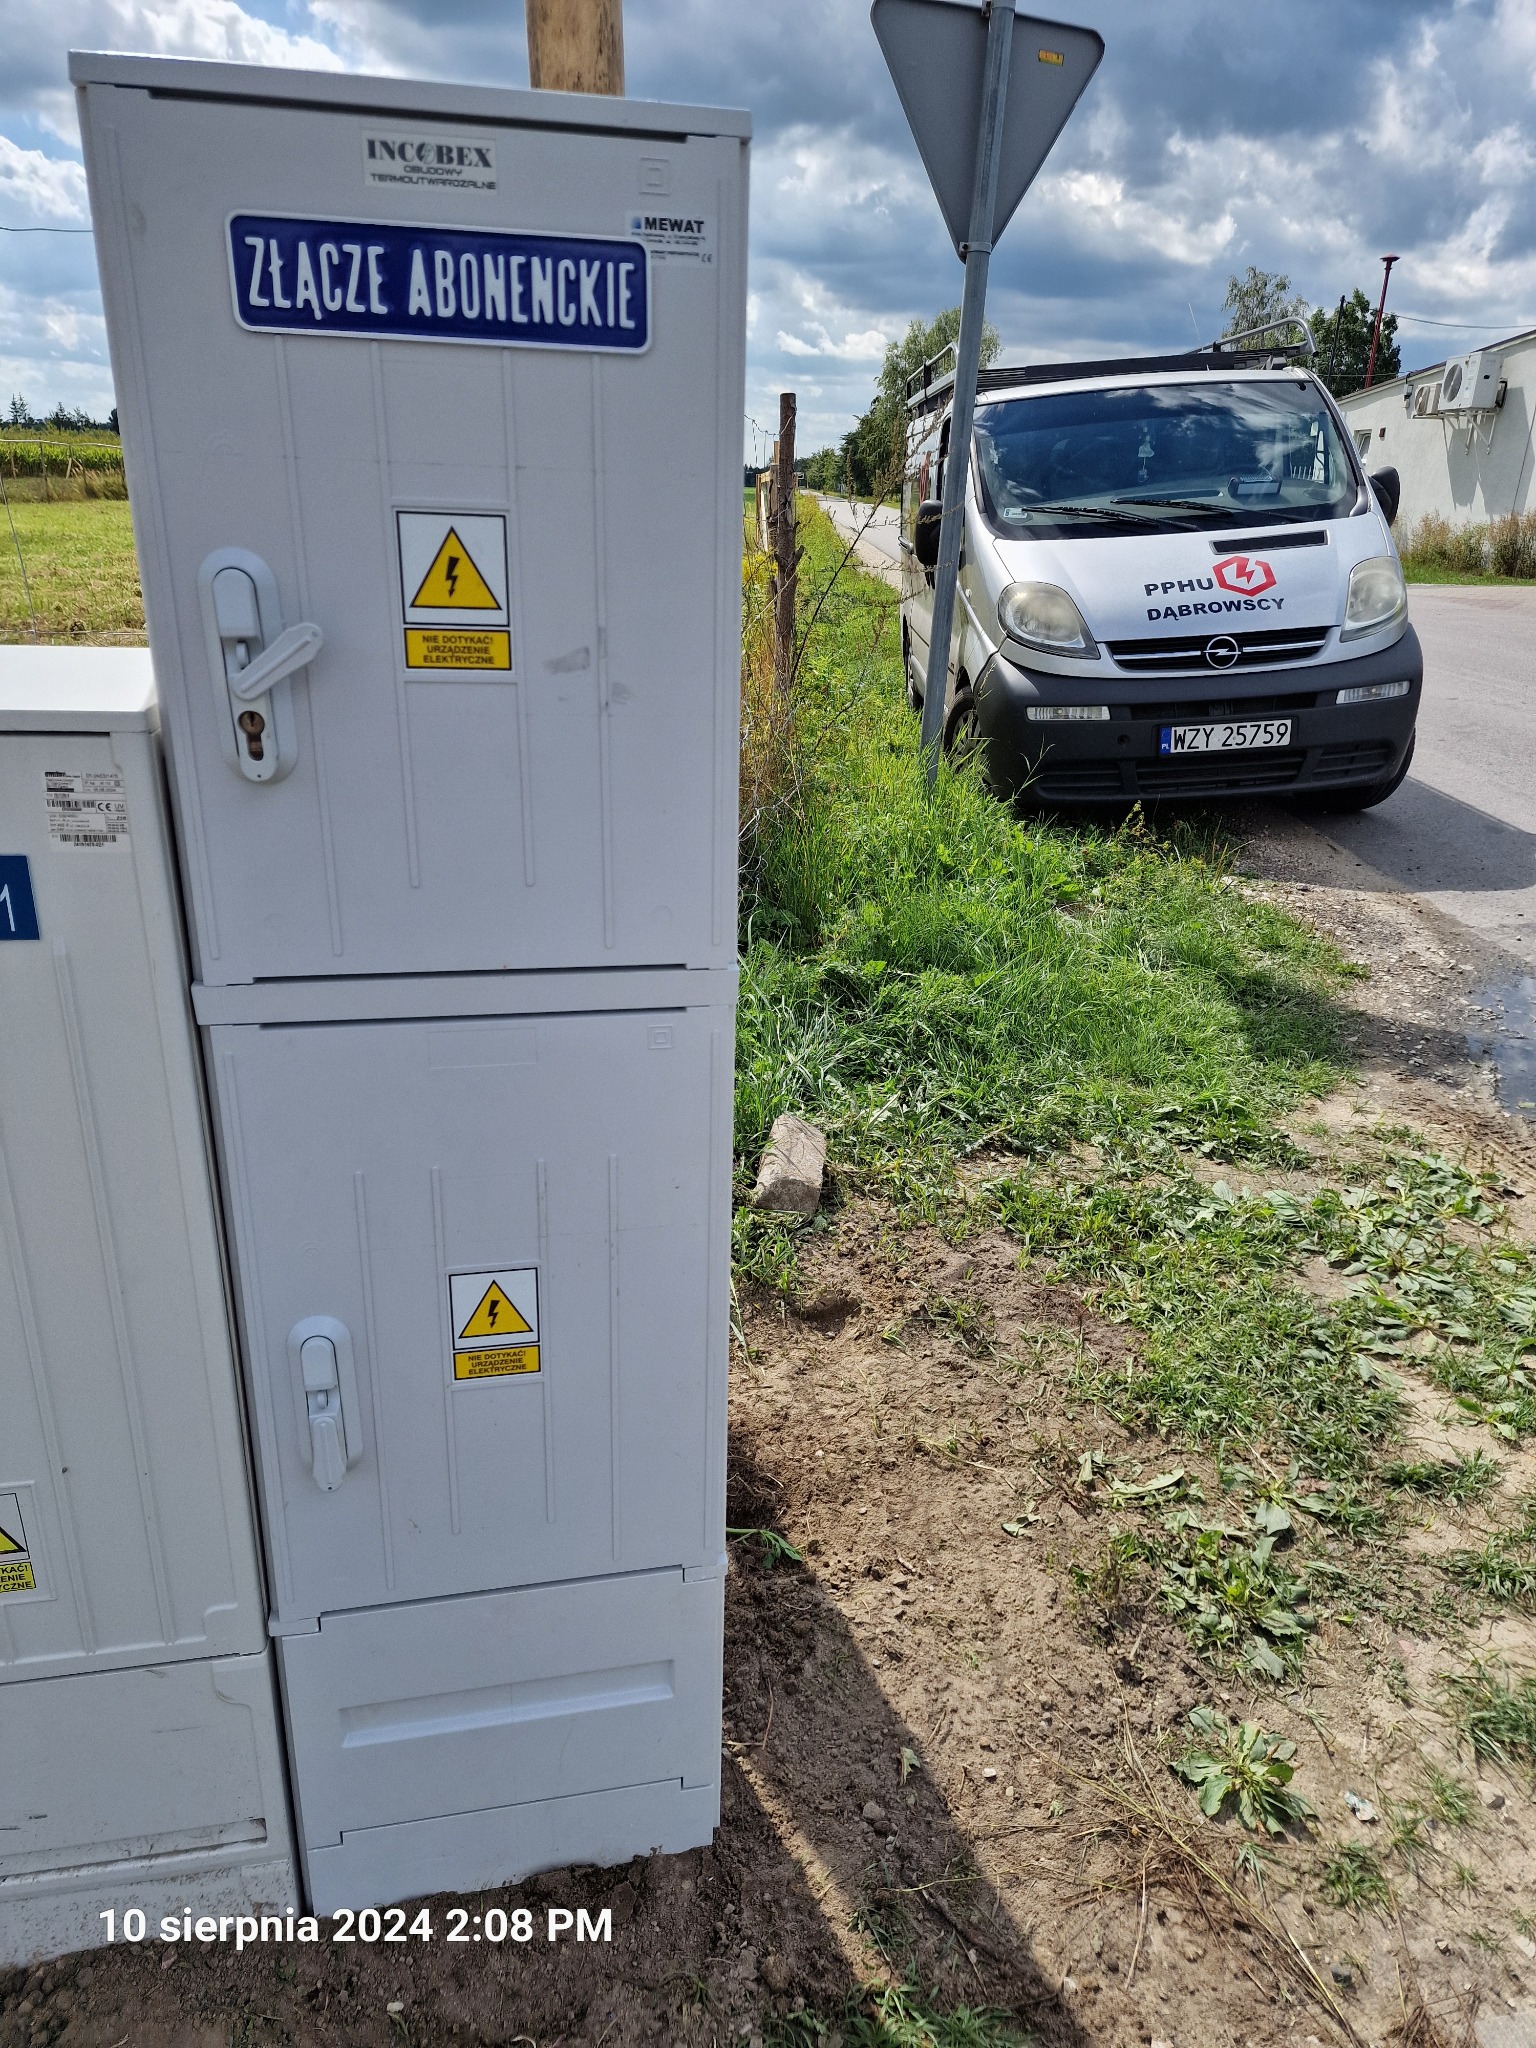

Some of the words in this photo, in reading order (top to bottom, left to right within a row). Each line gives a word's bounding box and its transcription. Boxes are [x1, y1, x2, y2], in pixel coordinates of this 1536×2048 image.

[366, 138, 493, 168] INCOBEX
[403, 165, 462, 176] OBUDOWY
[370, 173, 497, 189] TERMOUTWARDZALNE
[644, 216, 704, 233] MEWAT
[244, 236, 388, 320] ZŁĄCZE
[408, 248, 636, 329] ABONENCKIE
[1144, 577, 1214, 596] PPHU
[1147, 598, 1285, 621] DĄBROWSCY
[422, 635, 439, 644] NIE
[442, 635, 493, 644] DOTYKAĆ!
[426, 645, 490, 657] URZĄDZENIE
[423, 655, 494, 664] ELEKTRYCZNE
[1174, 727, 1215, 750] WZY
[1221, 722, 1289, 748] 25759
[484, 1350, 527, 1361] DOTYKAĆ!
[468, 1364, 527, 1375] ELEKTRYCZNE
[471, 1358, 523, 1368] URZĄDZENIE
